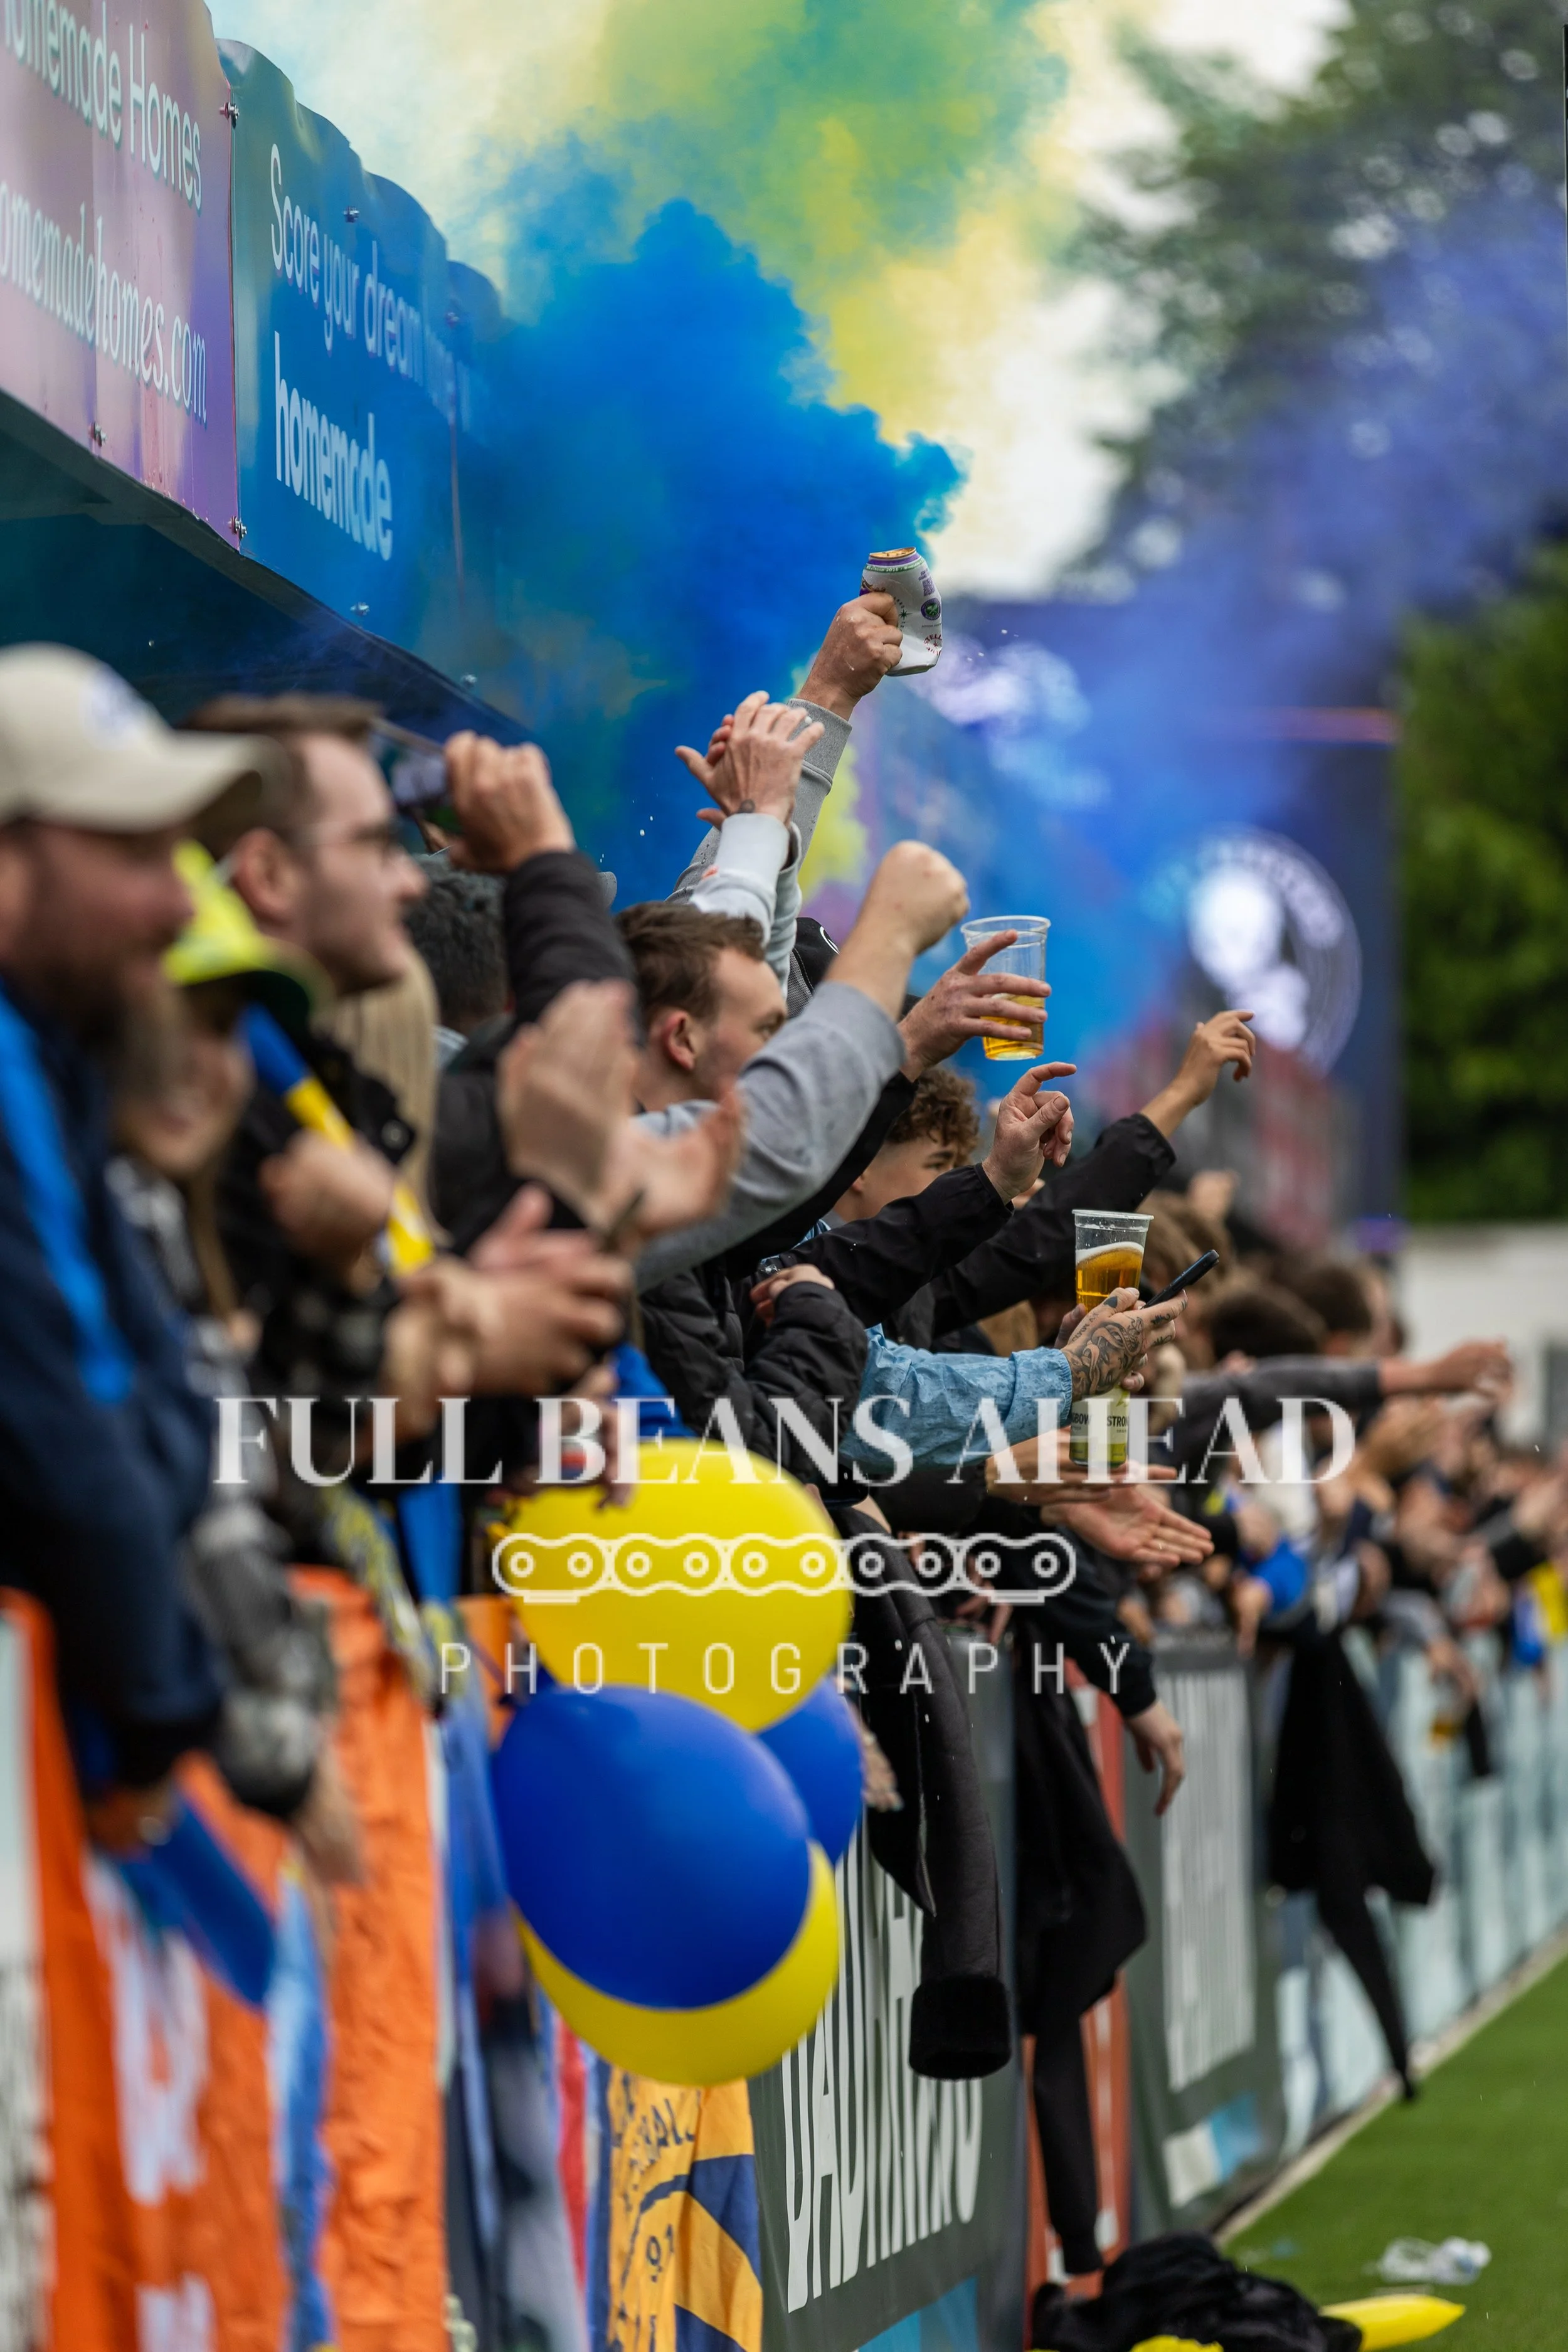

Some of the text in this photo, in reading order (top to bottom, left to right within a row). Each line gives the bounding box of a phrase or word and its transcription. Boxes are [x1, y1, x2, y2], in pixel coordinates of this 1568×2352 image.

[129, 23, 201, 210] Homes
[270, 143, 320, 303] Score
[324, 233, 359, 351] your
[364, 240, 423, 386] dream
[274, 331, 393, 561] homemade
[923, 633, 942, 645] STELL
